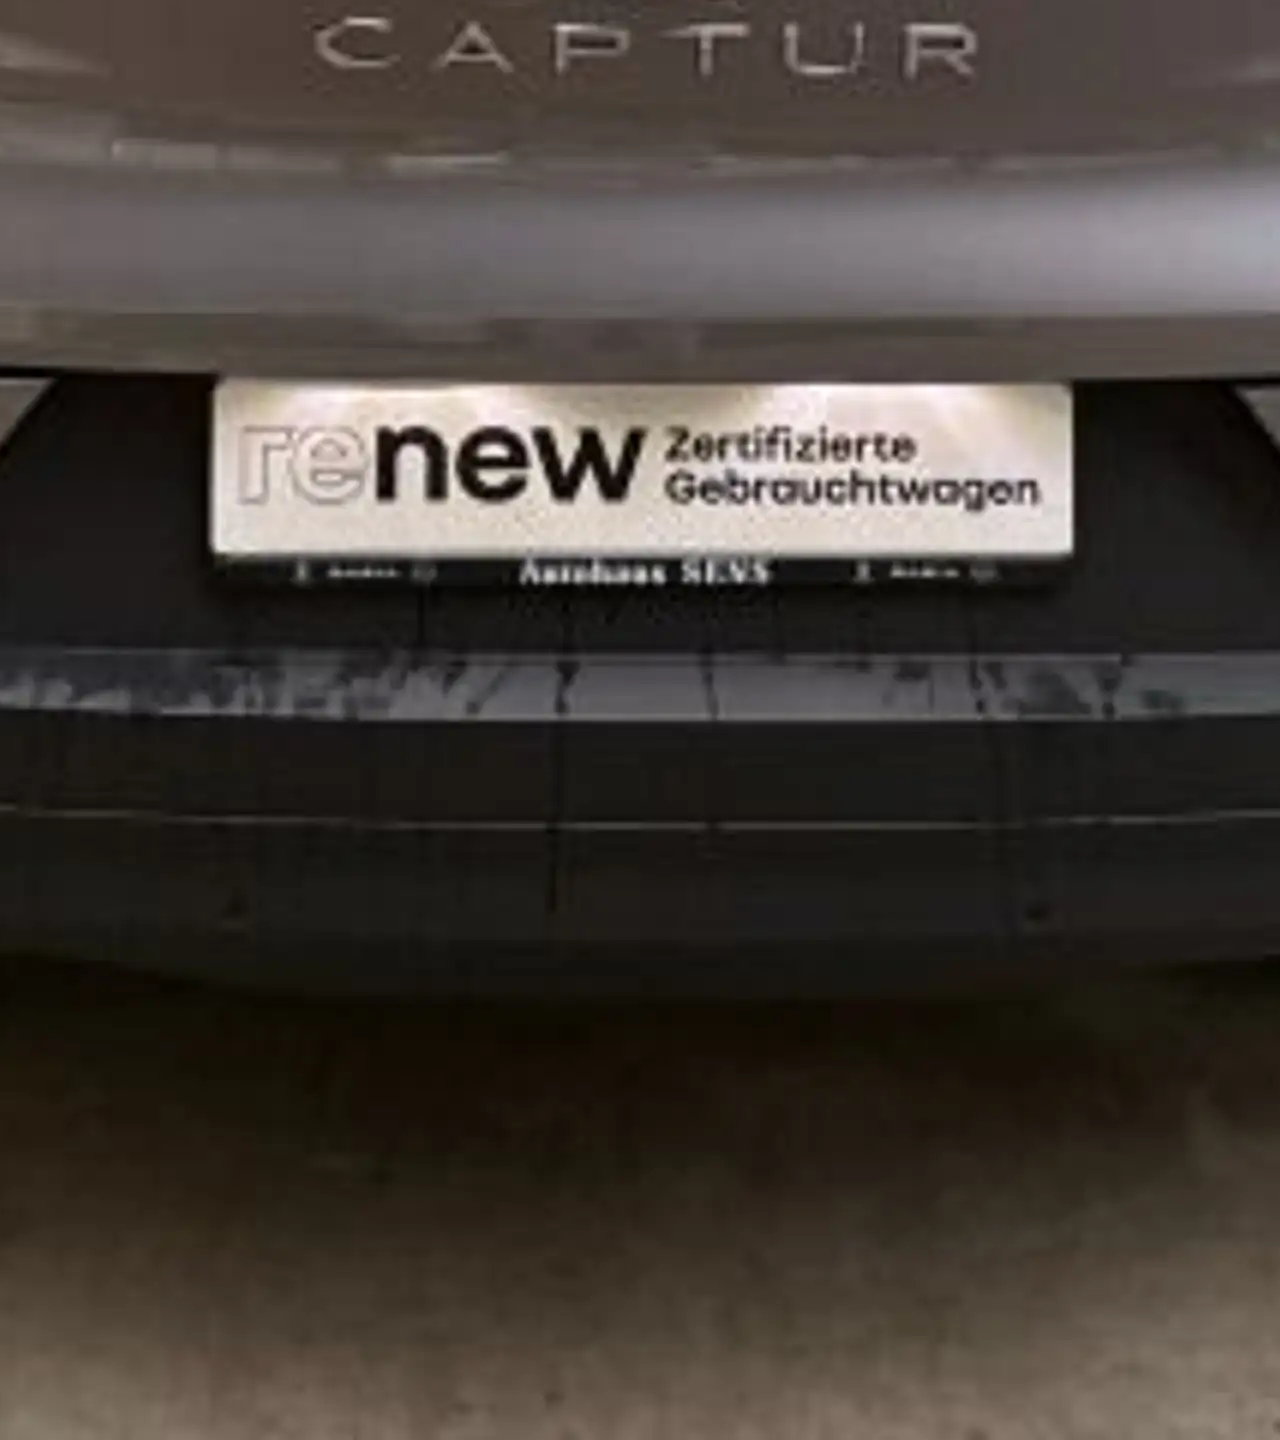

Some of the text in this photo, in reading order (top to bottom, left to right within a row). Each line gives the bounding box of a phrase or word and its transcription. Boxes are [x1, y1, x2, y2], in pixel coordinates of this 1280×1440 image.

[317, 16, 980, 77] CAPTUR
[237, 424, 648, 506] renew
[663, 423, 918, 462] Zertifizierte
[663, 467, 1041, 513] Gebrauchtwagen
